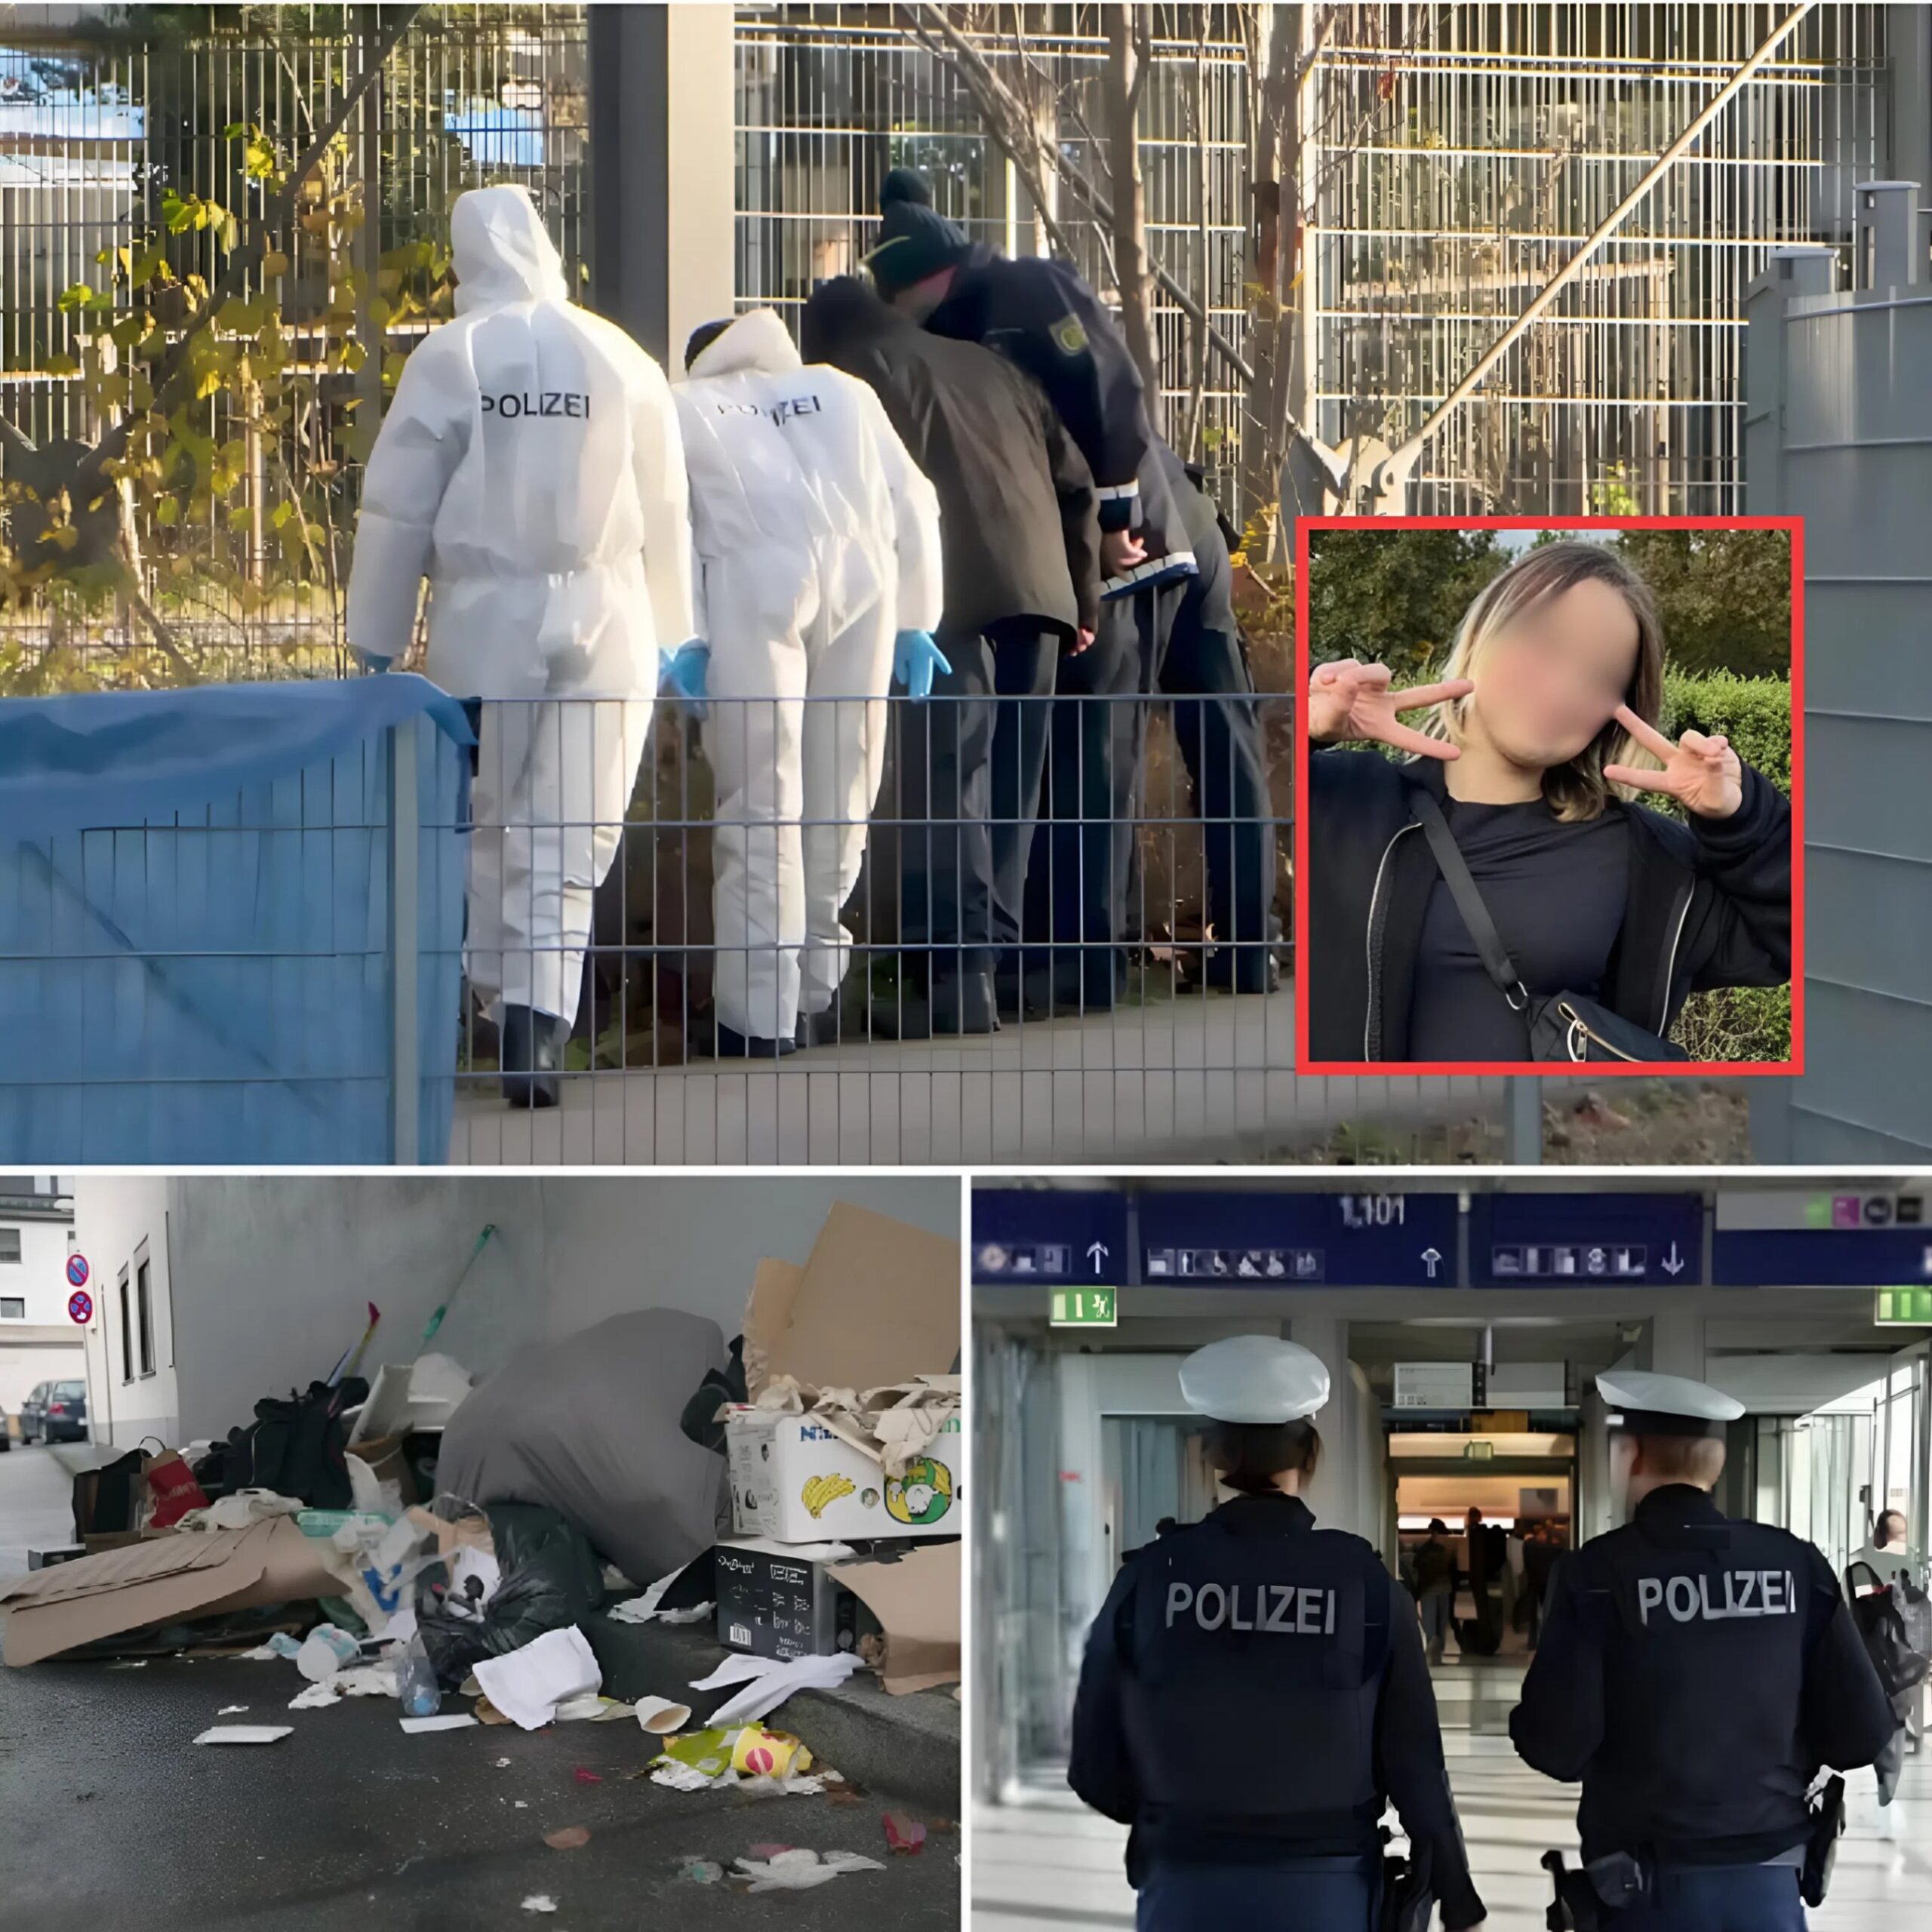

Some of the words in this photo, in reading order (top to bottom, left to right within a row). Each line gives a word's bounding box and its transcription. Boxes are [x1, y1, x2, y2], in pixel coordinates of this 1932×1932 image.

[481, 392, 589, 419] POLIZEI
[1166, 1582, 1335, 1634] POLIZEI
[1638, 1570, 1796, 1626] POLIZEI
